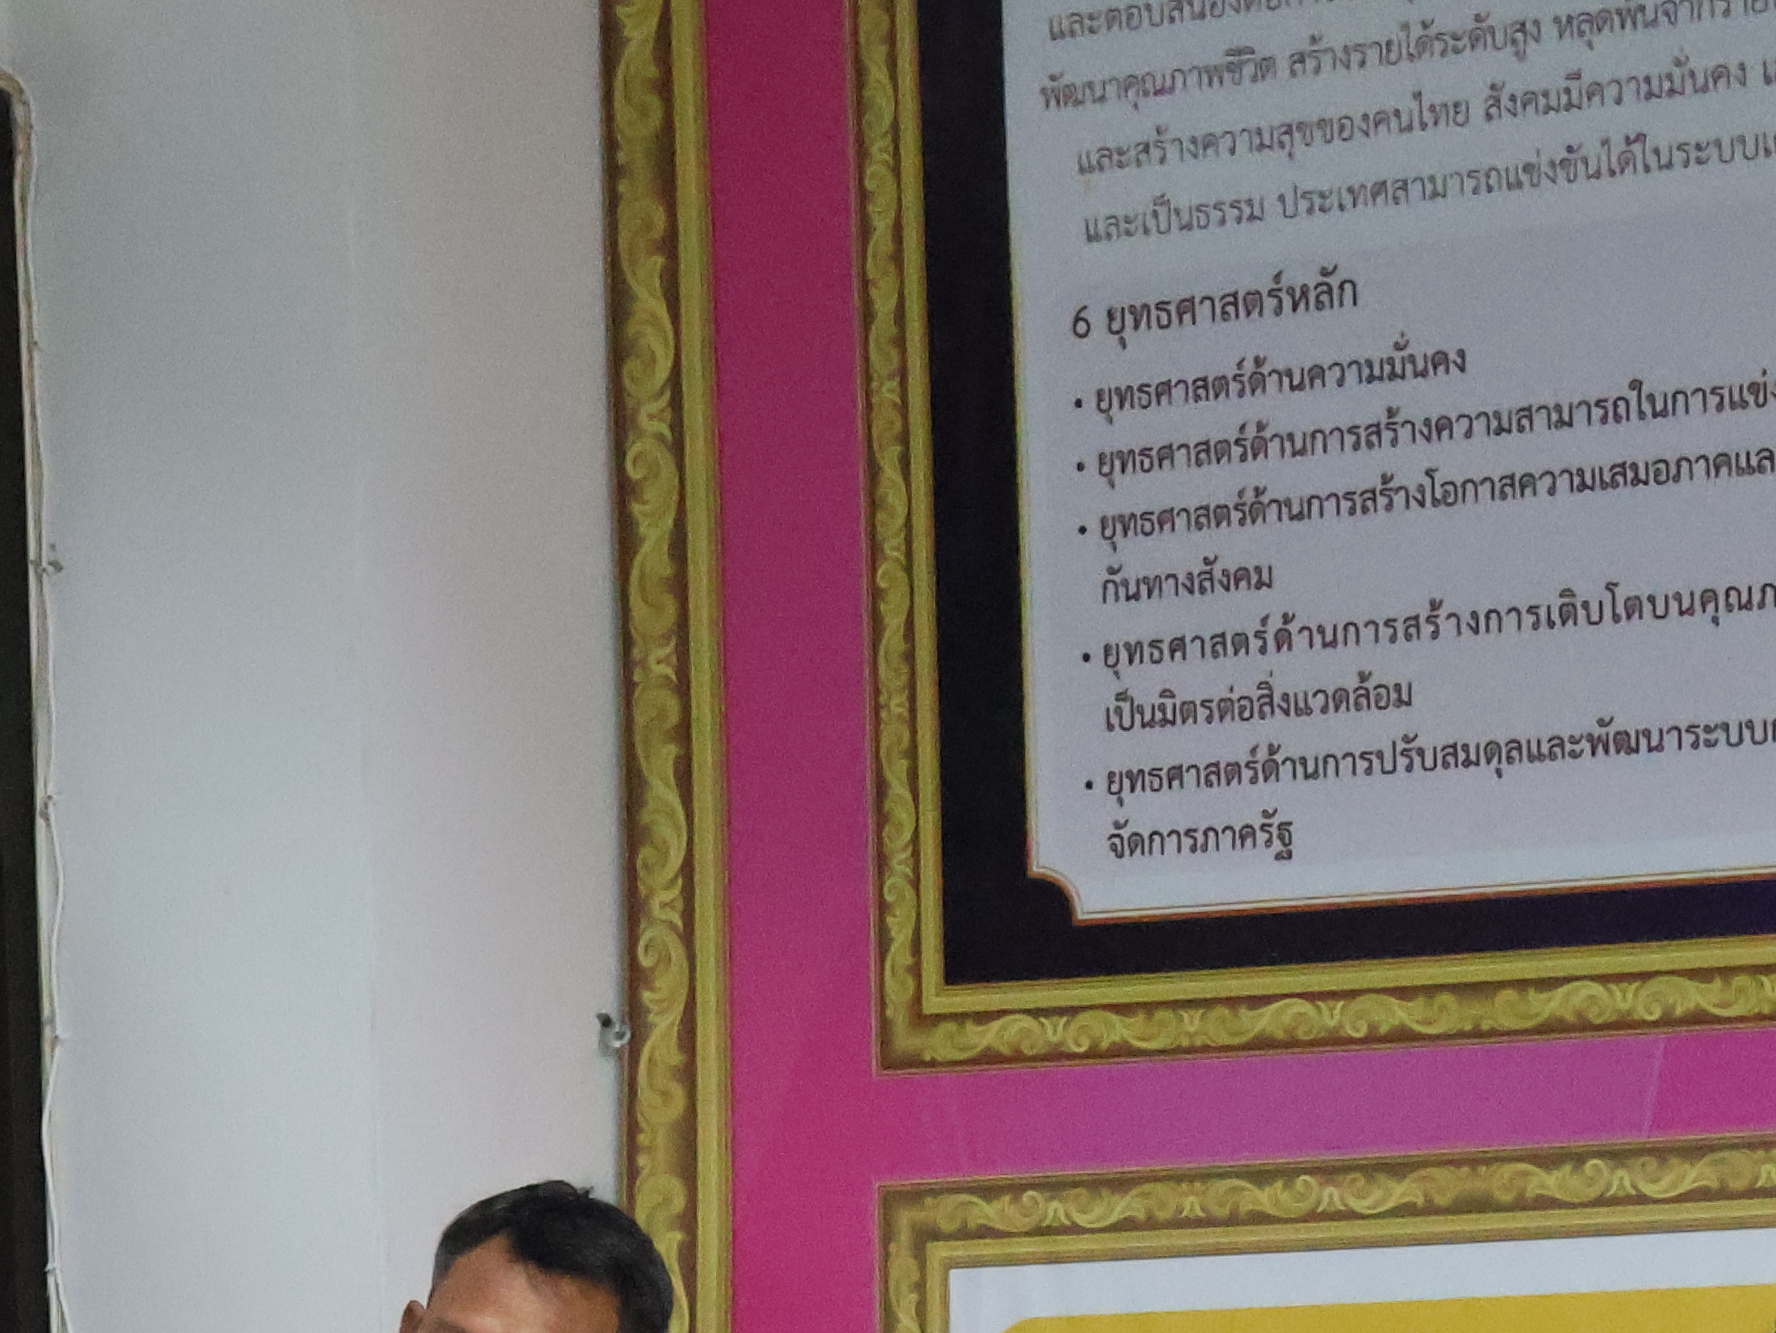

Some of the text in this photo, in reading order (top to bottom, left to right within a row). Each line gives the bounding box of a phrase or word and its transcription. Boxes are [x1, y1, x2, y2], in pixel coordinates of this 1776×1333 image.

[1085, 131, 1776, 243] และเป็นธรรม ประเทศสามารถแข่งขันได้ในระบบเ
[1072, 263, 1358, 350] 6 ยุทธศาสตร์หลัก
[1096, 331, 1467, 425] ยุทธศาสตร์ด้านความมั่นคง
[1101, 554, 1273, 605] กันทางสังคม
[1105, 670, 1413, 733] เป็นมิตรต่อสิ่งแวดล้อม
[1107, 715, 1776, 807] ยุทธศาสตร์ด้านการปรับสมดุลและพัฒนาระบบ
[1107, 807, 1294, 861] จัดการภาครัฐ
